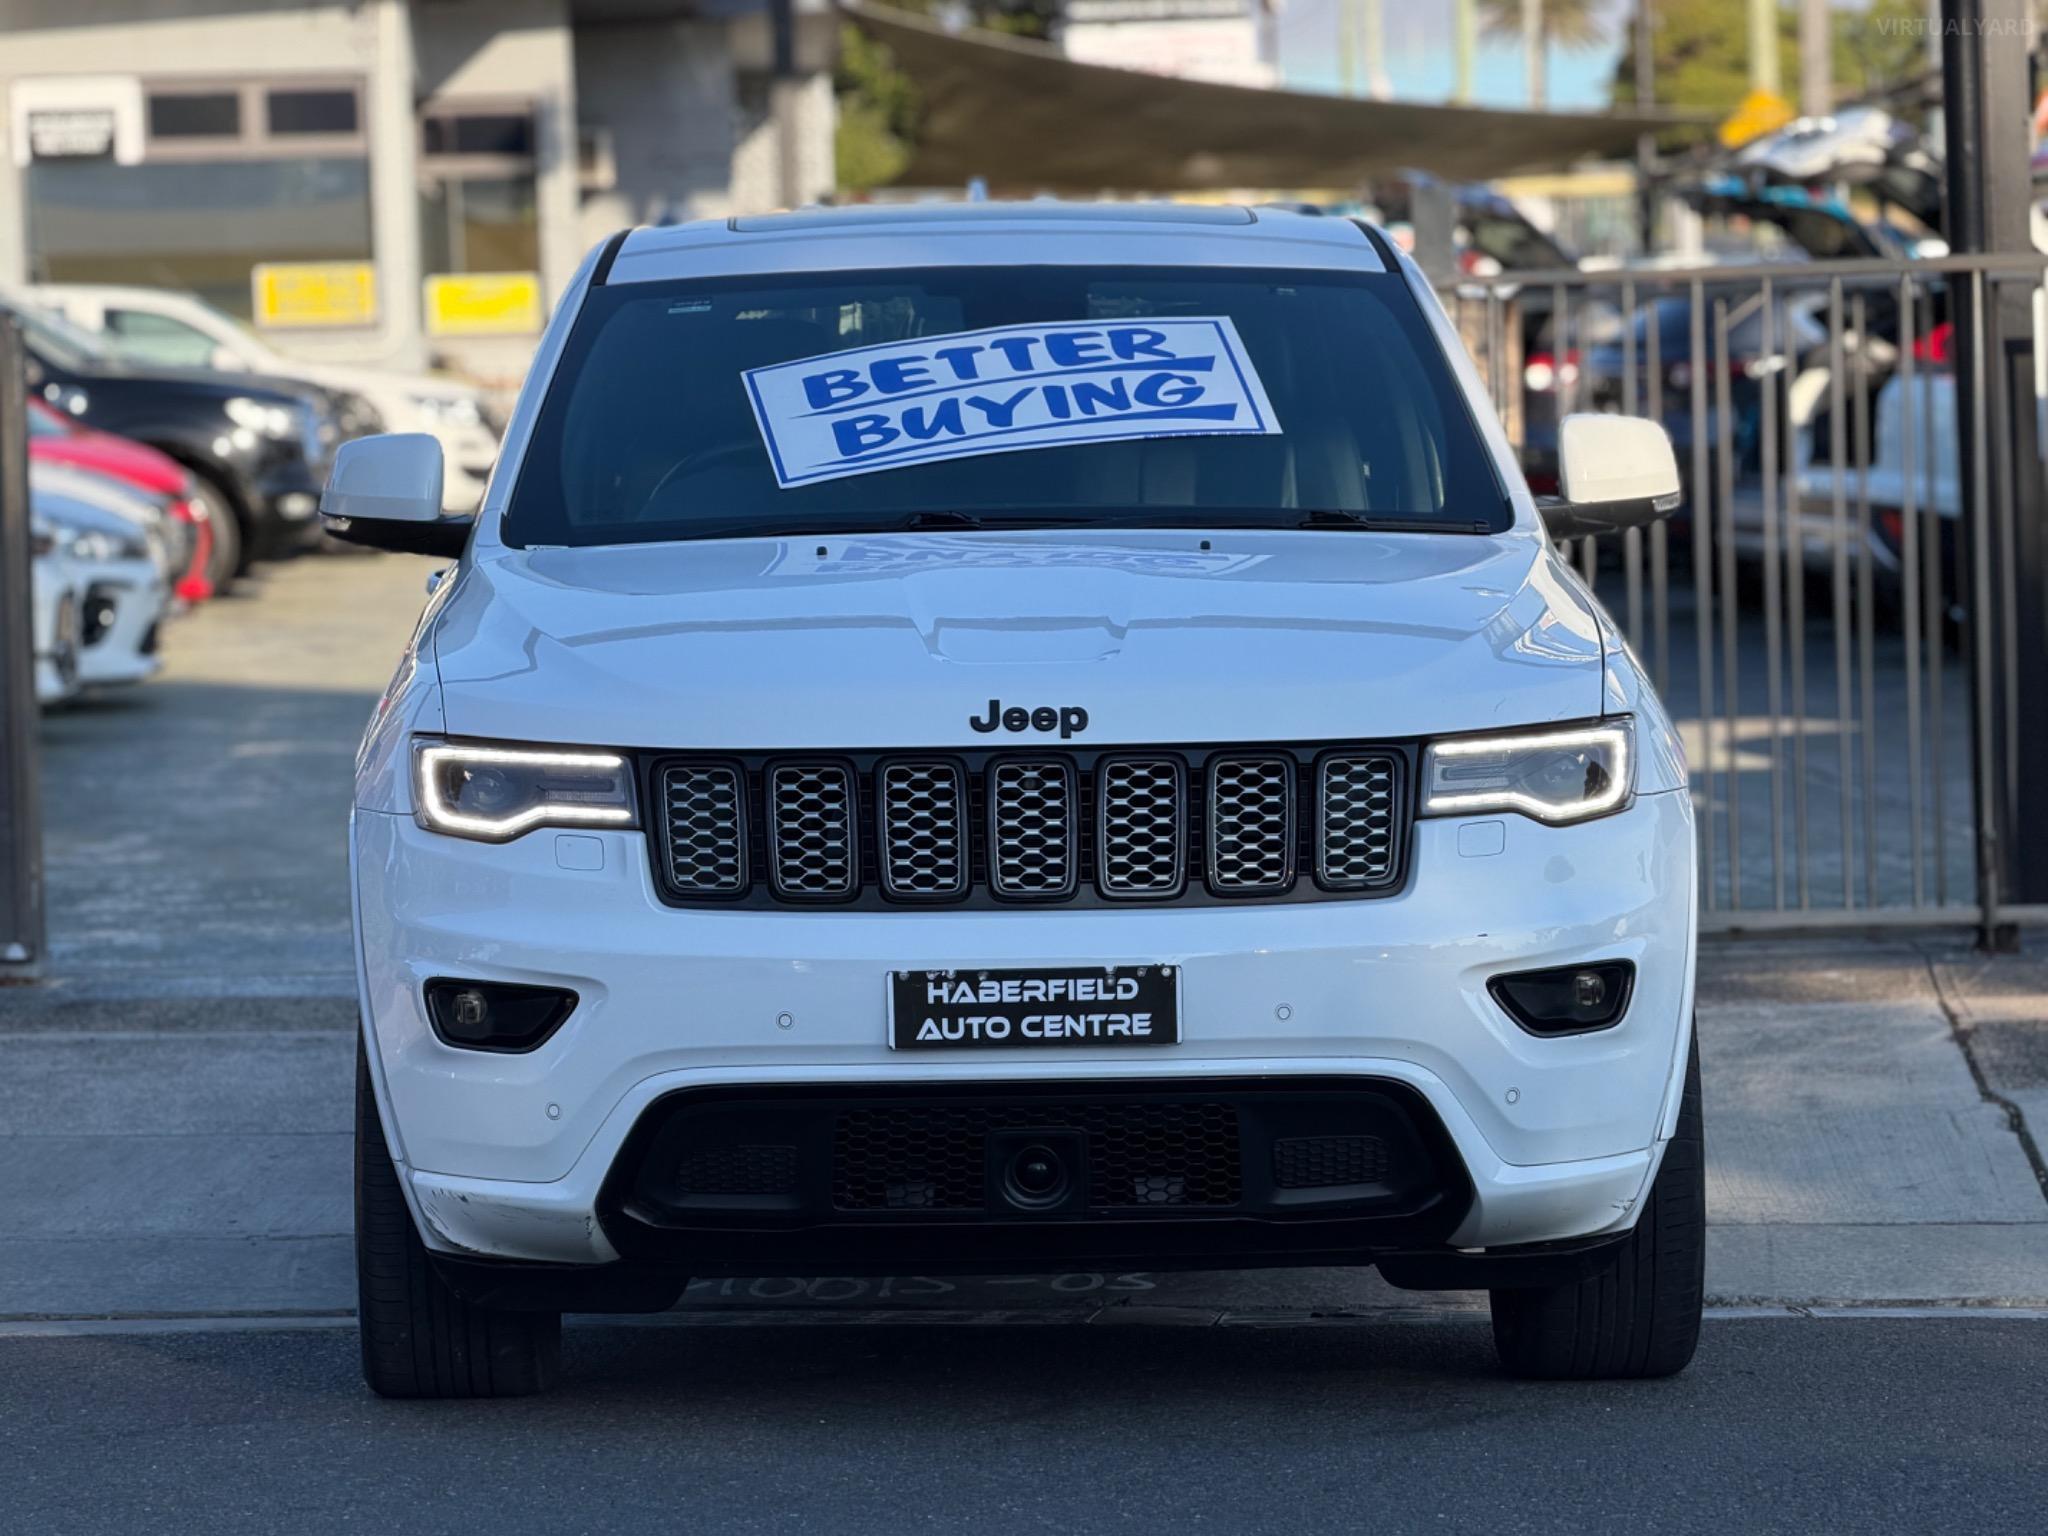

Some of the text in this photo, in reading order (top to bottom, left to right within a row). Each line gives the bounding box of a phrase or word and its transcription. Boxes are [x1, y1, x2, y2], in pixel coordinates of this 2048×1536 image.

[802, 328, 1177, 409] BETTER
[831, 372, 1206, 457] BUYING
[969, 699, 1089, 739] Jeep
[927, 977, 1139, 1004] HABERFIELD
[916, 1013, 1152, 1041] AUTO CENTRE
